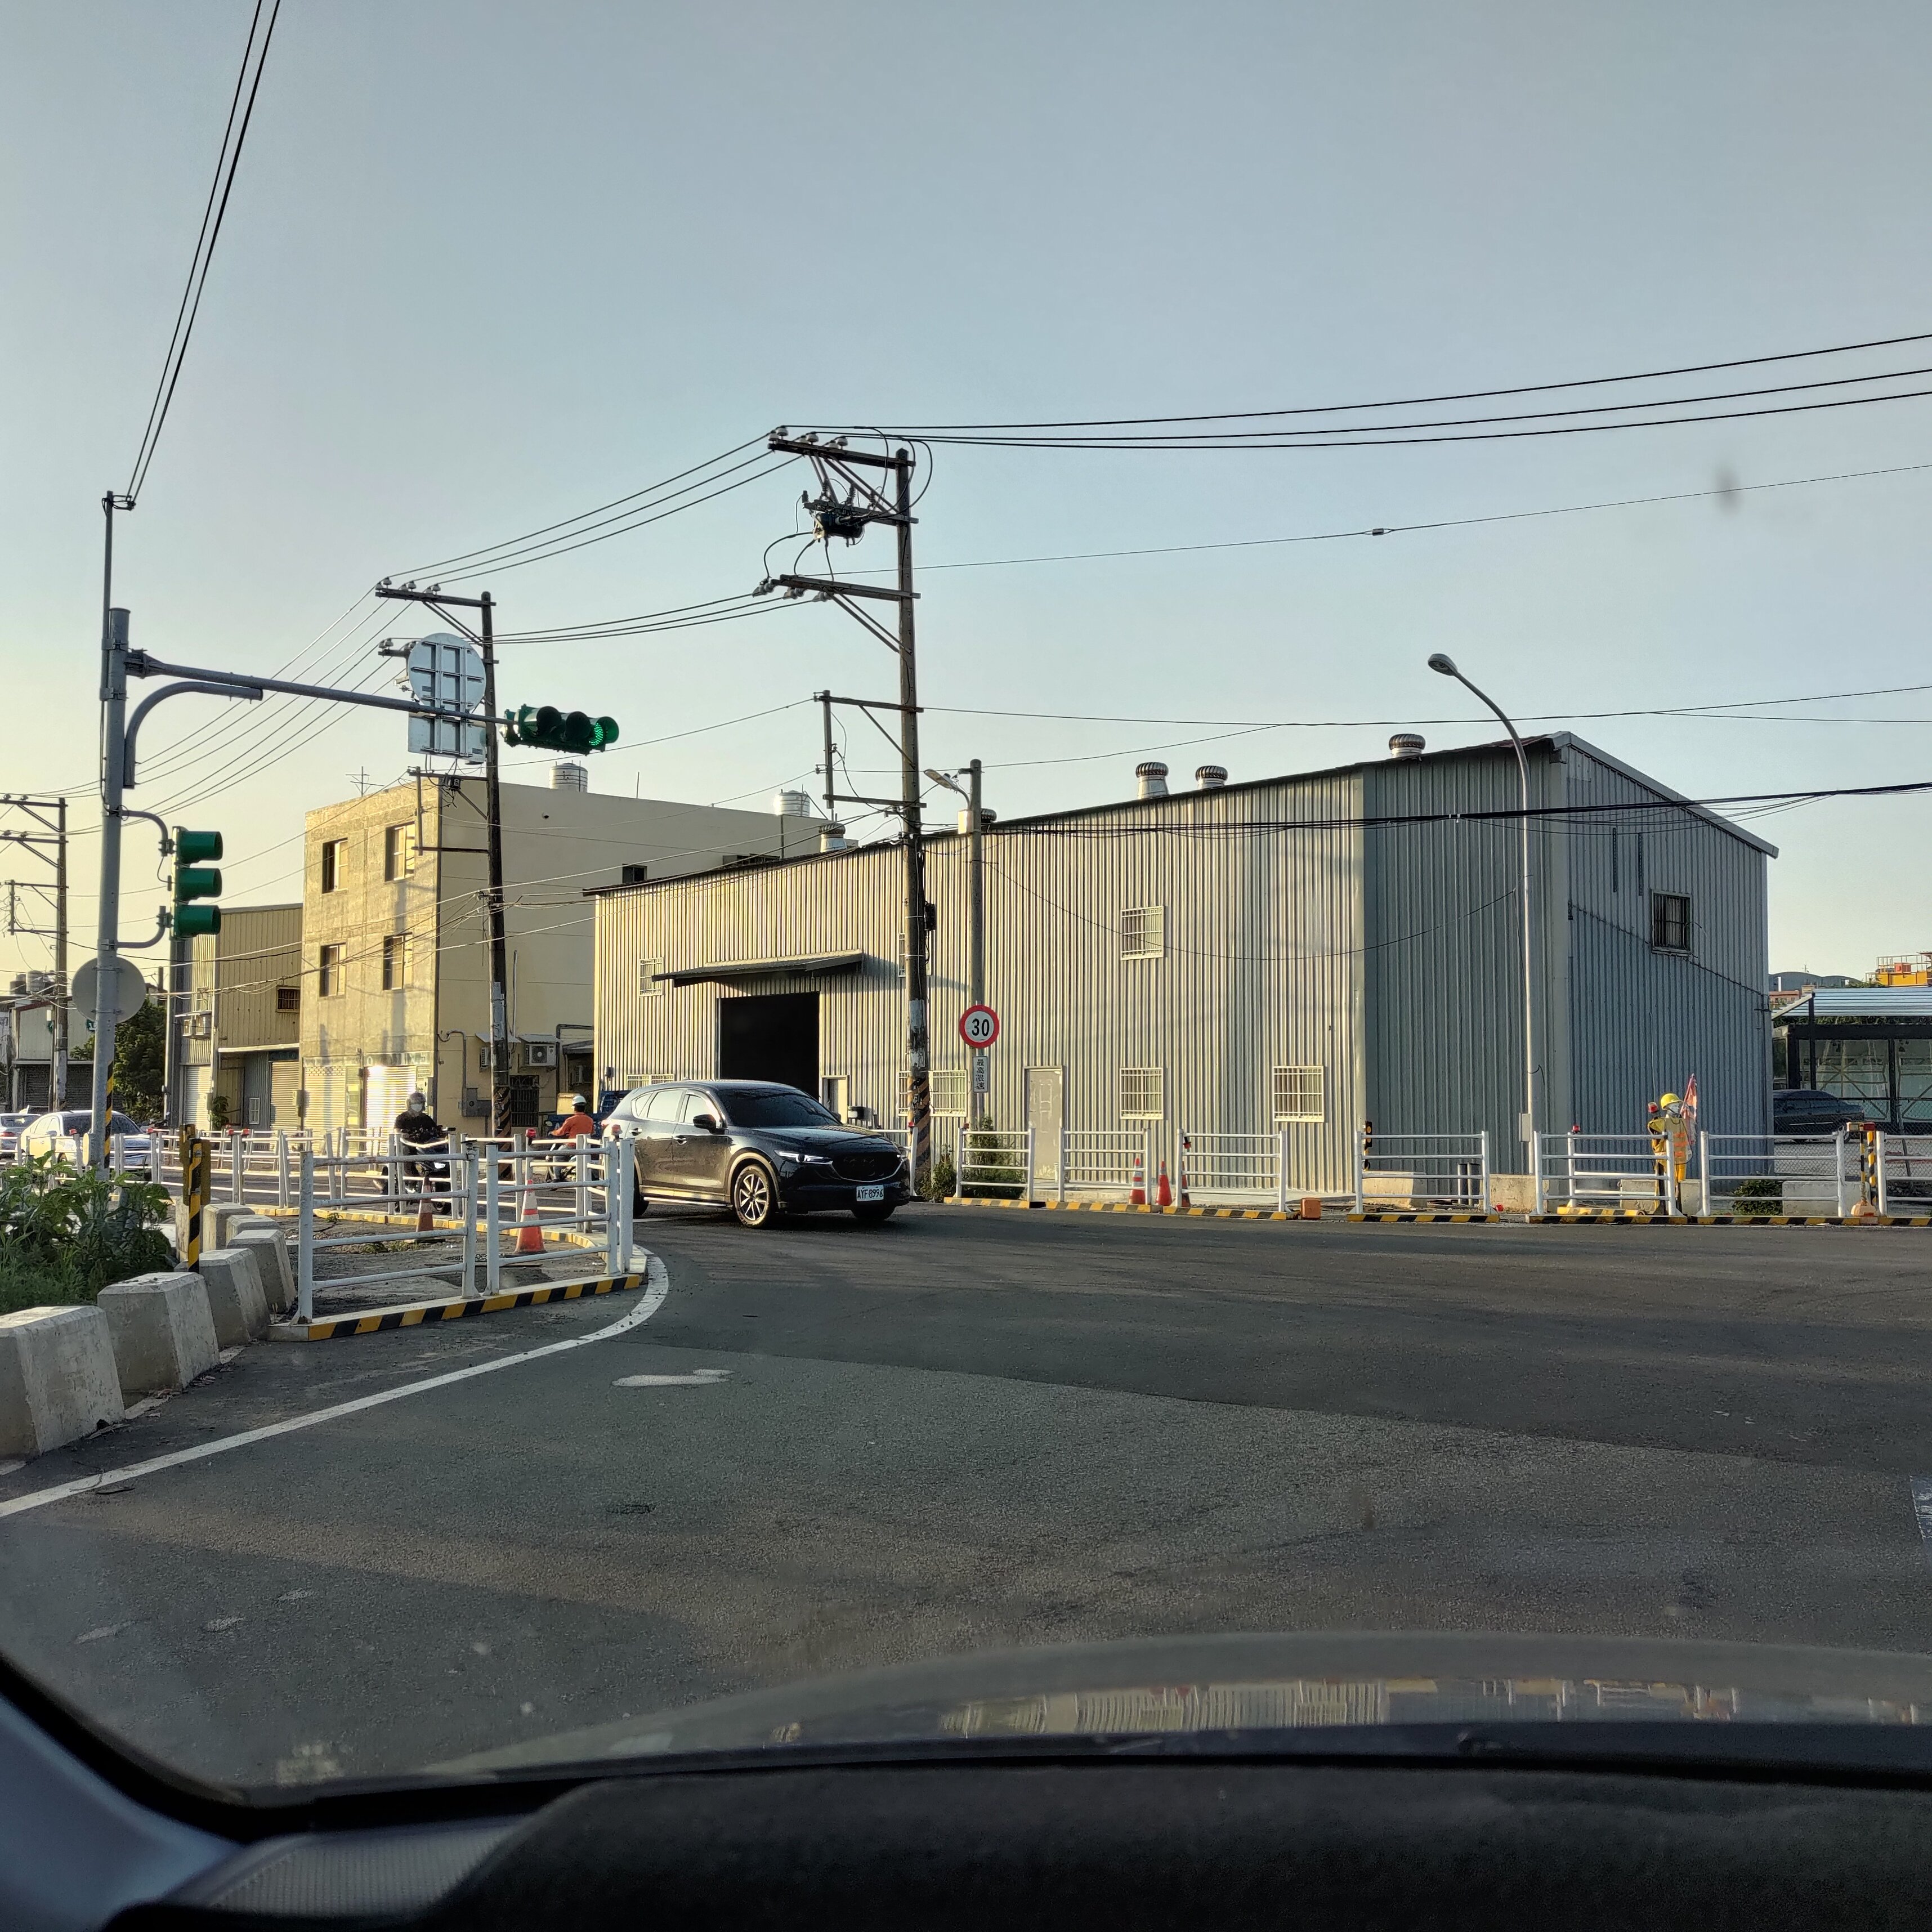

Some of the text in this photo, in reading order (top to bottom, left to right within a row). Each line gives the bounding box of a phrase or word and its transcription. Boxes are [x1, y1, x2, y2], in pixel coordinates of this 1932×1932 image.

[971, 1018, 990, 1037] 30
[975, 1058, 985, 1090] 最高限速
